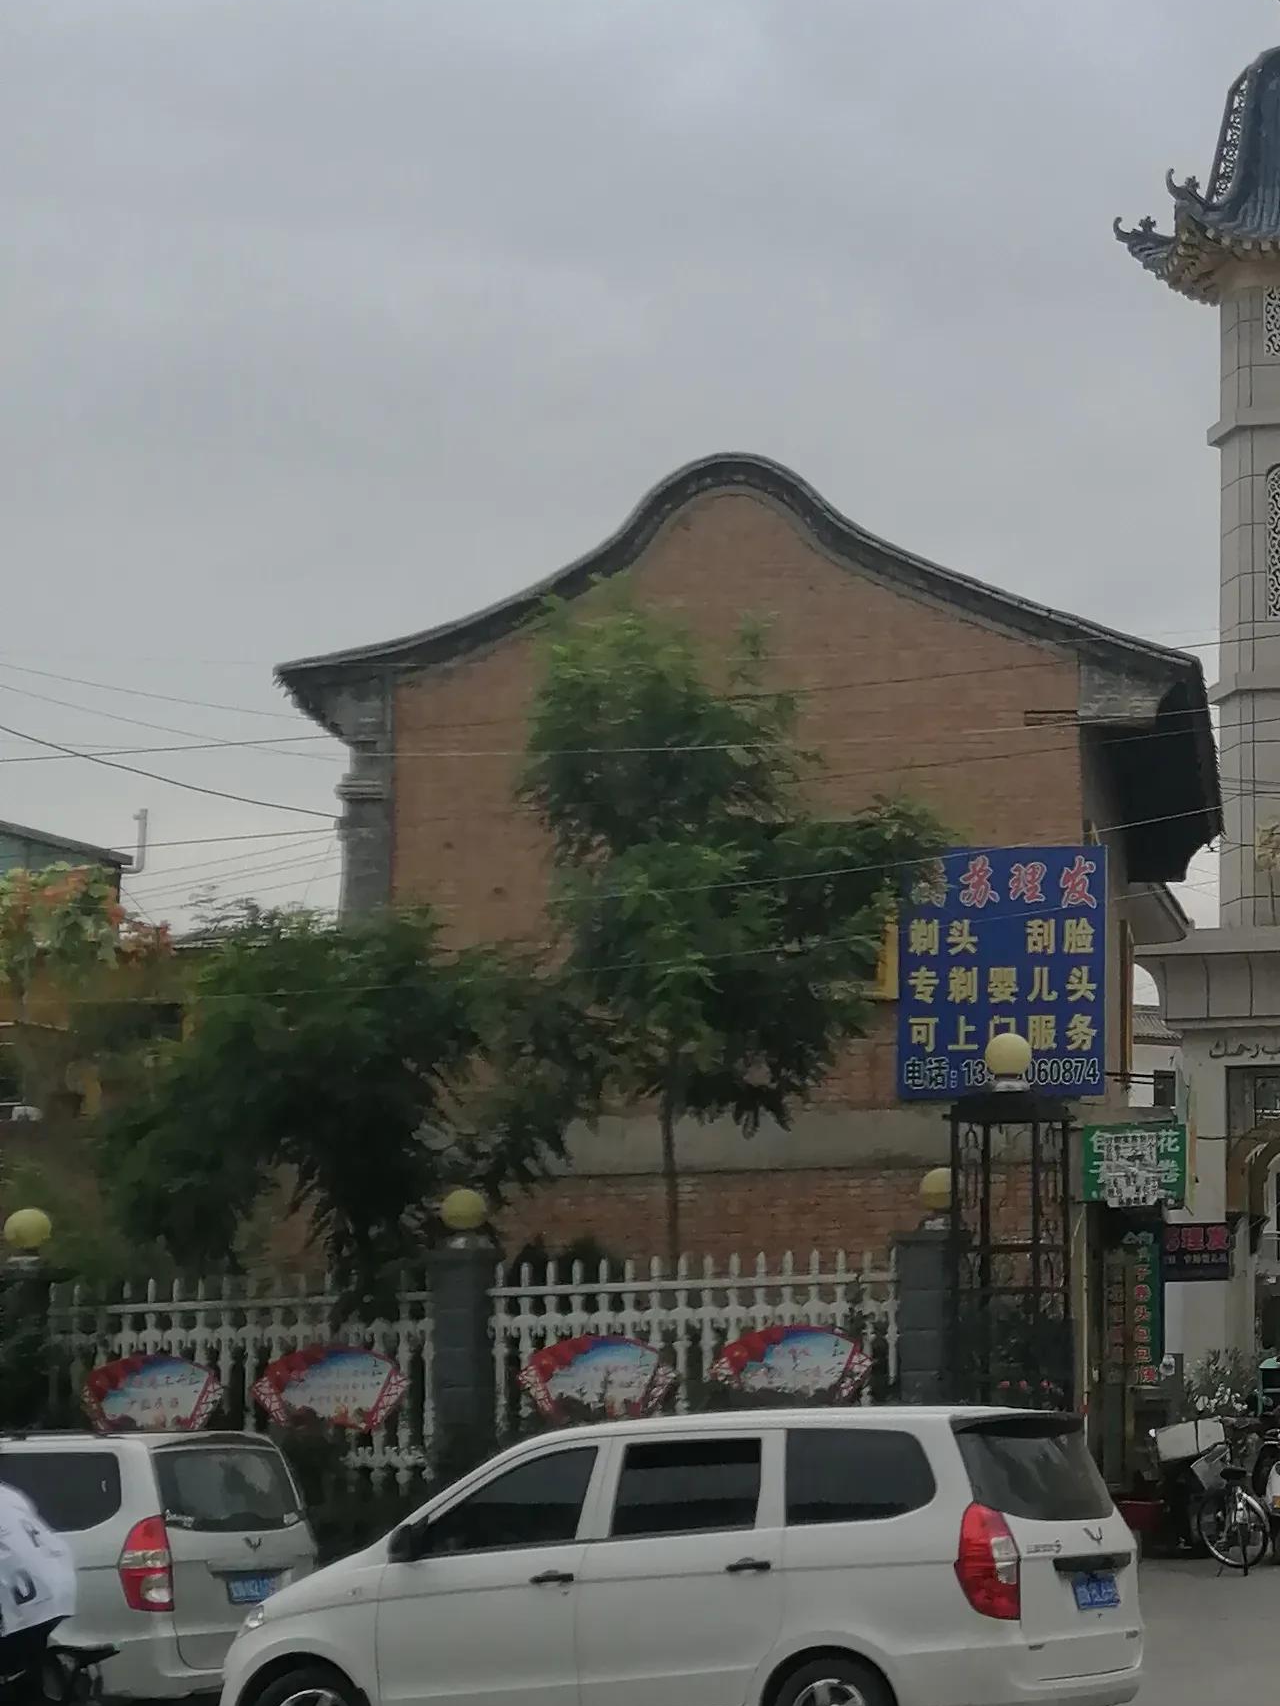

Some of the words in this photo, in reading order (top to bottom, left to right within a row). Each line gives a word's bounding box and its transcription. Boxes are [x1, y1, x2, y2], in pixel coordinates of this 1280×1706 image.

[908, 918, 979, 956] 剃头
[1025, 917, 1096, 955] 刮脸
[907, 966, 1097, 1004] 专剃婴儿头
[904, 1057, 1099, 1089] 电话：13060874
